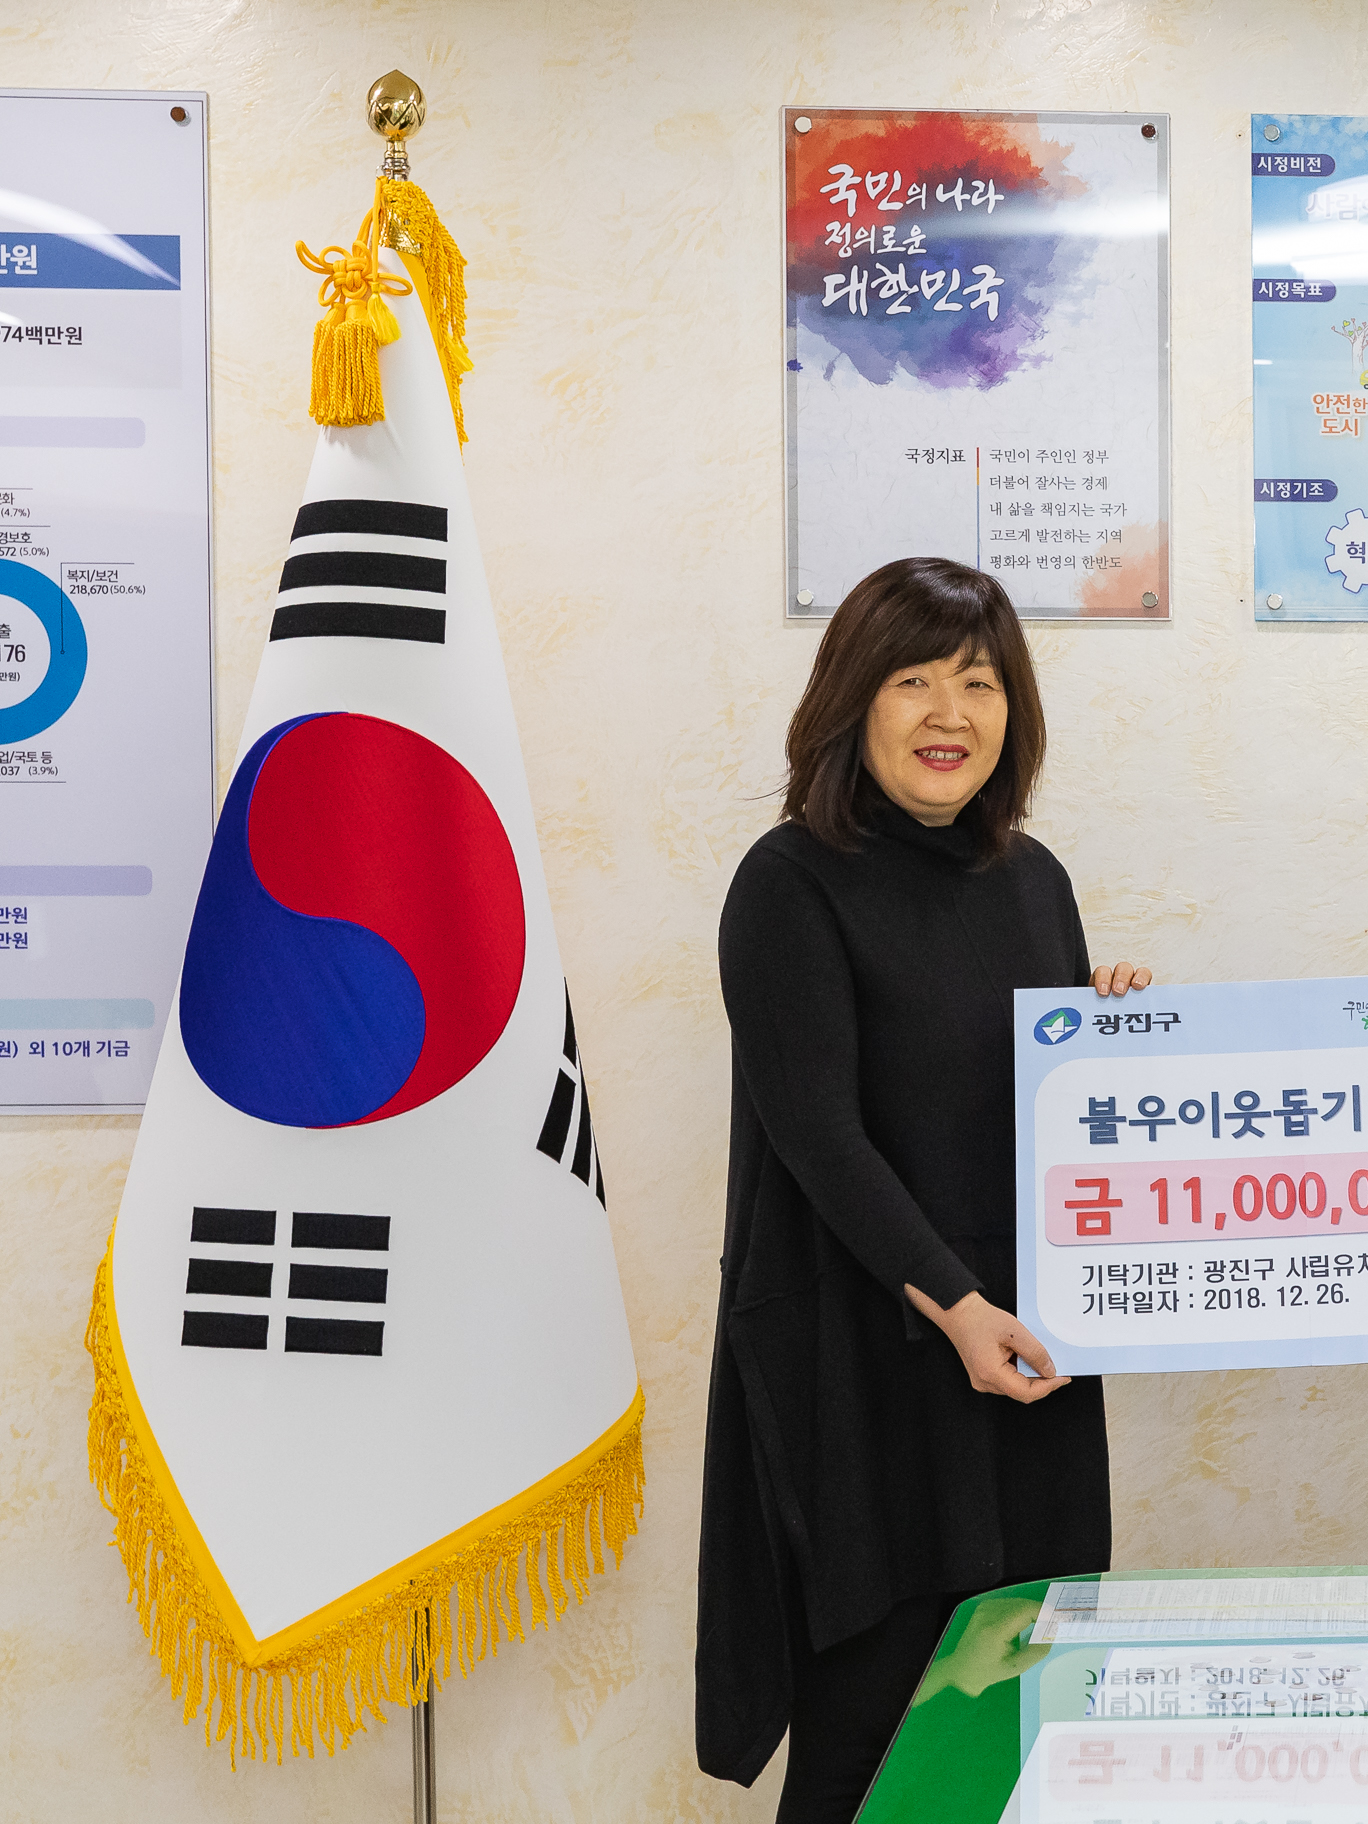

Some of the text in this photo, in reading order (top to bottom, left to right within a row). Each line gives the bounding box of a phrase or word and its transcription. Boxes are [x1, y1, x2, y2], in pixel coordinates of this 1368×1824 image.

[1257, 155, 1323, 174] 시정비전
[819, 163, 1005, 217] 국민의 나라
[824, 222, 927, 258] 정의로운
[821, 262, 1005, 322] 대한민국
[1258, 282, 1323, 299] 시정목표
[0, 325, 83, 346] 74백만원
[1313, 393, 1368, 415] 안전한
[1321, 418, 1359, 437] 도시
[904, 448, 966, 464] 국정지표
[989, 448, 1110, 464] 국민이 주인인 정부
[989, 475, 1108, 491] 더불어 잘사는 경제
[1260, 481, 1325, 498] 시정기조
[0, 492, 15, 506] 화
[0, 508, 31, 518] (4.7%)
[989, 502, 1128, 518] 내 삶을 책임지는 국가
[989, 528, 1123, 544] 고르게 발전하는 지역
[19, 546, 50, 557] (5.0%)
[989, 554, 1123, 570] 평화와 번영의 한반도
[66, 569, 119, 582] 복지/보건
[0, 644, 26, 663] 76
[41, 751, 53, 764] 등
[28, 766, 58, 776] (3.9%)
[1092, 1012, 1182, 1035] 광진구
[29, 1040, 45, 1058] 외
[52, 1040, 91, 1058] 10개
[96, 1040, 131, 1058] 기금
[1079, 1084, 1362, 1145] 불우이웃돕기
[1064, 1177, 1123, 1236] 금
[1082, 1261, 1179, 1289] 기탁기관
[1203, 1256, 1276, 1283] 광진구
[1082, 1289, 1180, 1316] 기탁일자
[1203, 1287, 1266, 1312] 2018.
[1276, 1285, 1310, 1308] 12.
[1316, 1283, 1350, 1306] 26.
